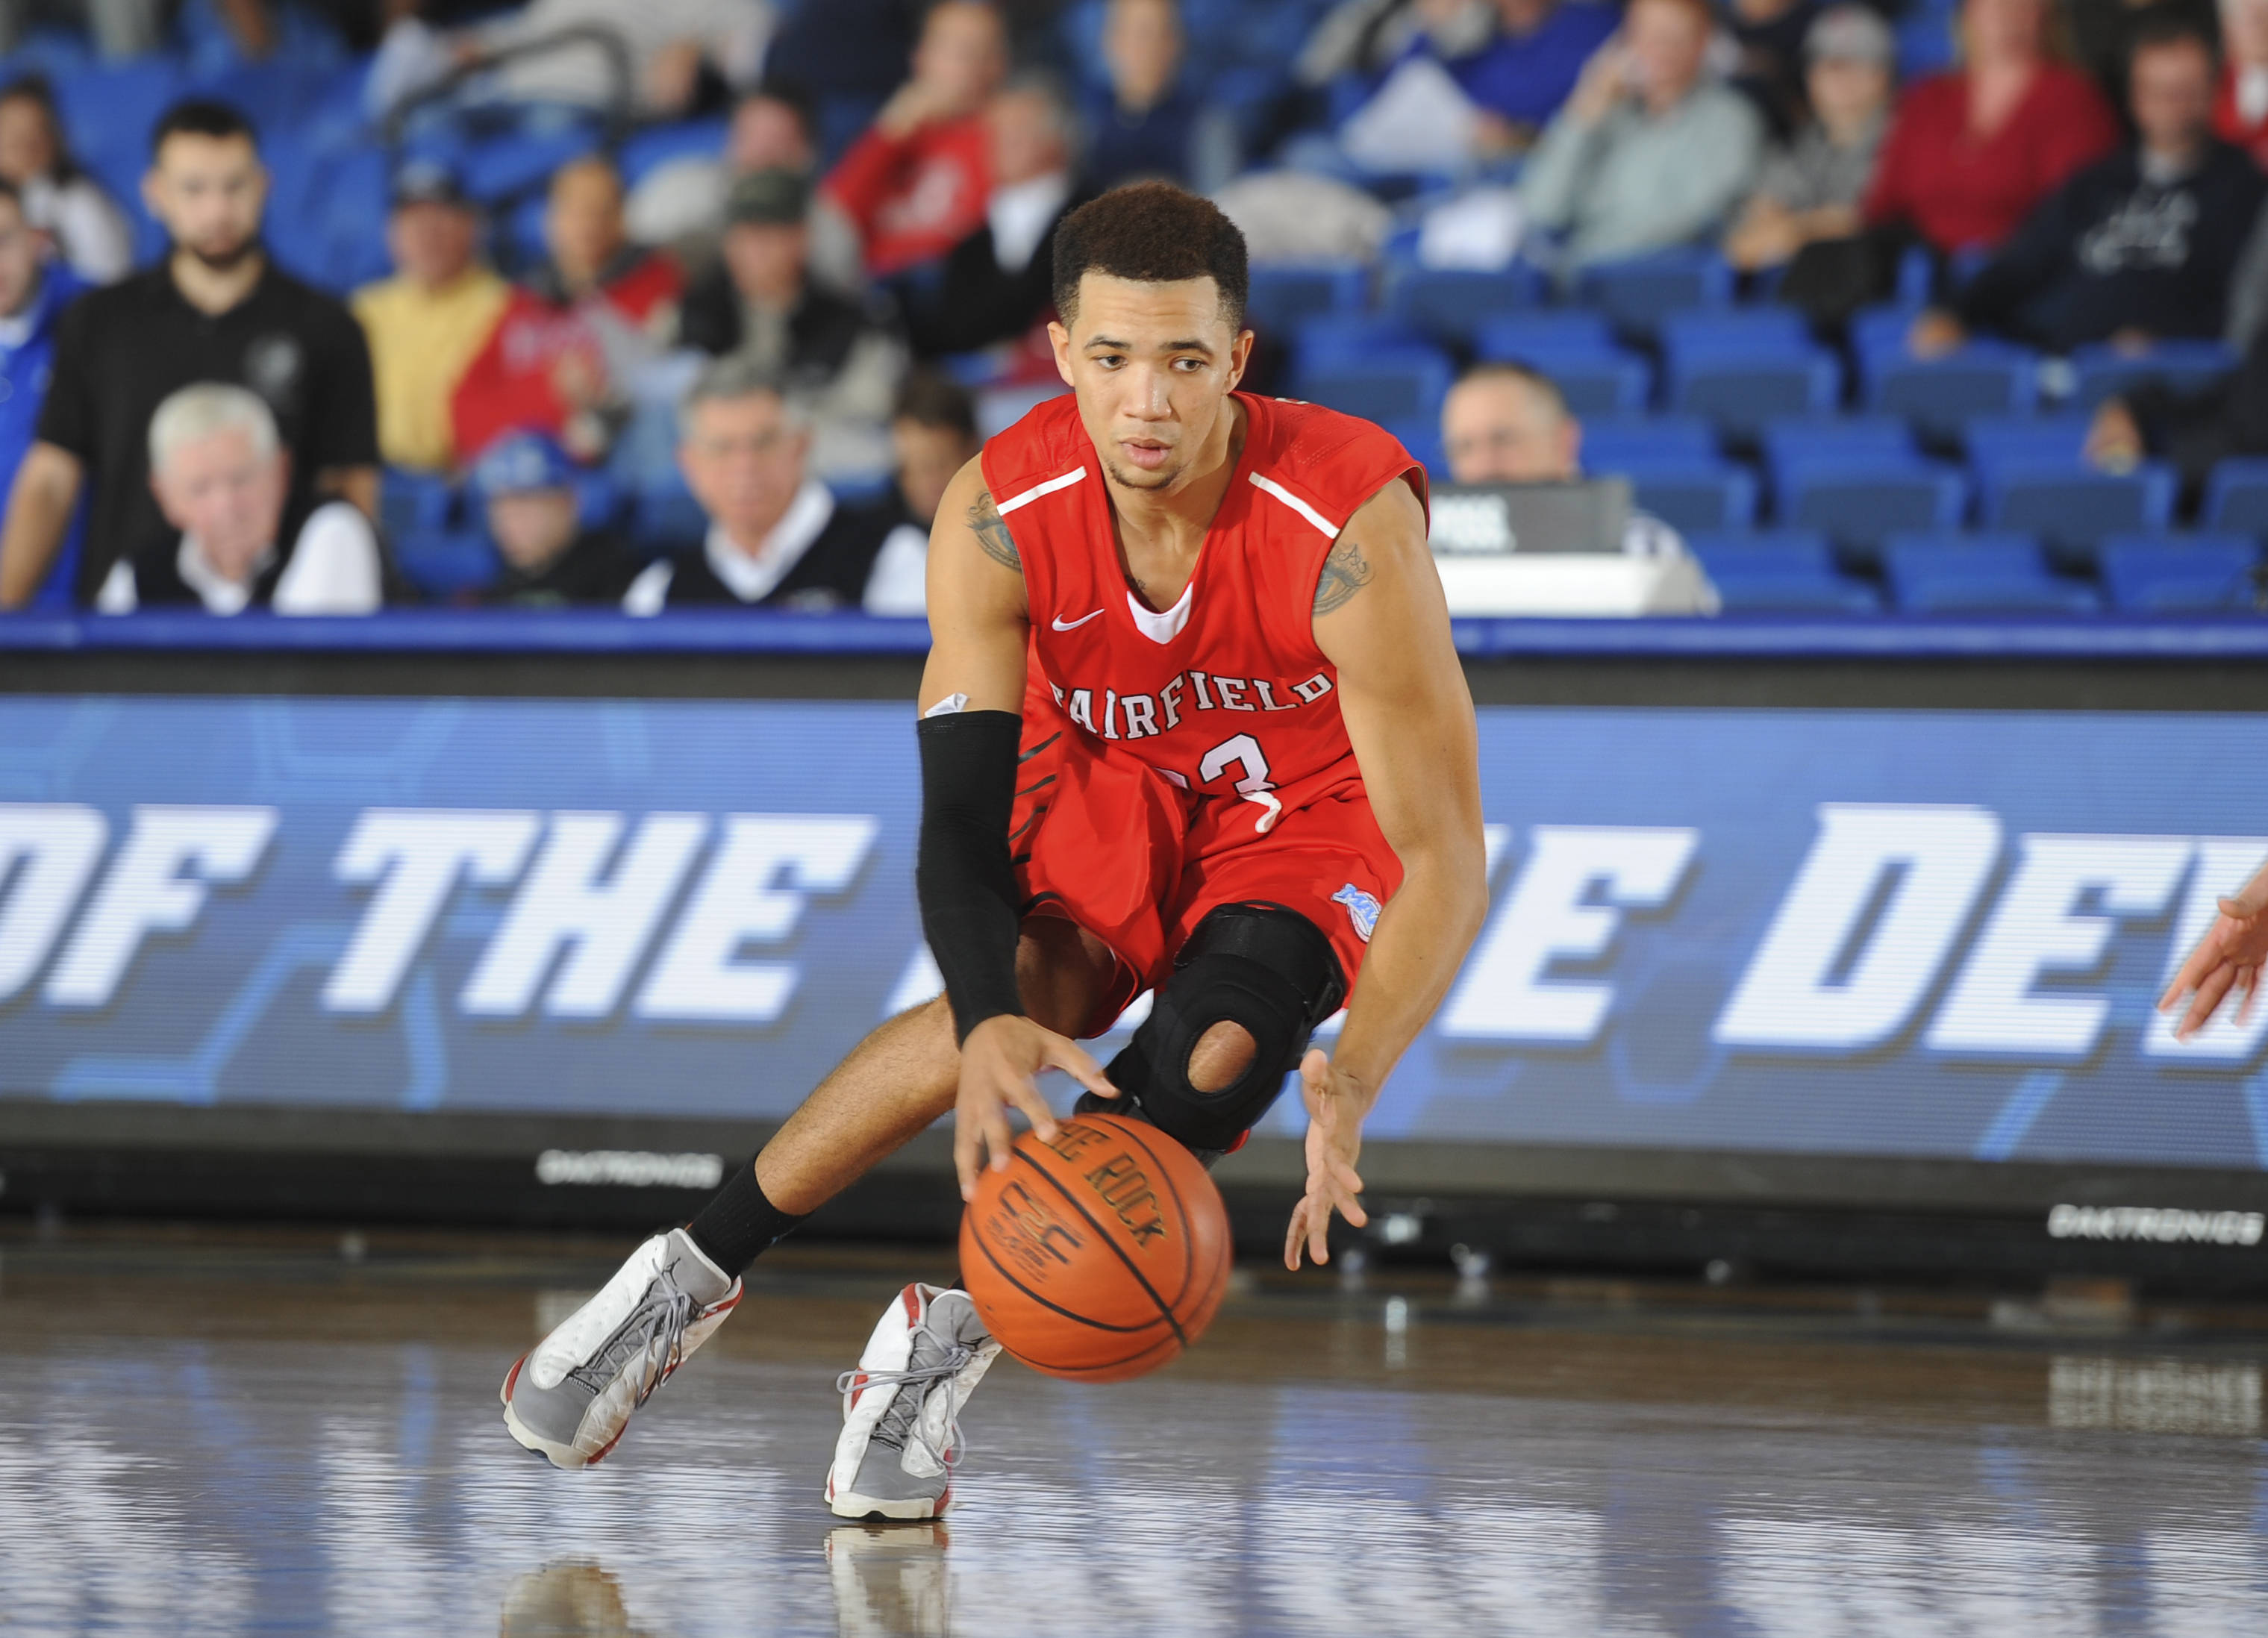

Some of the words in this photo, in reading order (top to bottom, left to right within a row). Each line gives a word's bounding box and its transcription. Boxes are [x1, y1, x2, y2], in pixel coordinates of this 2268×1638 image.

[319, 807, 879, 1021] THE
[1036, 1120, 1112, 1162] HE
[1083, 1151, 1168, 1249] ROCK
